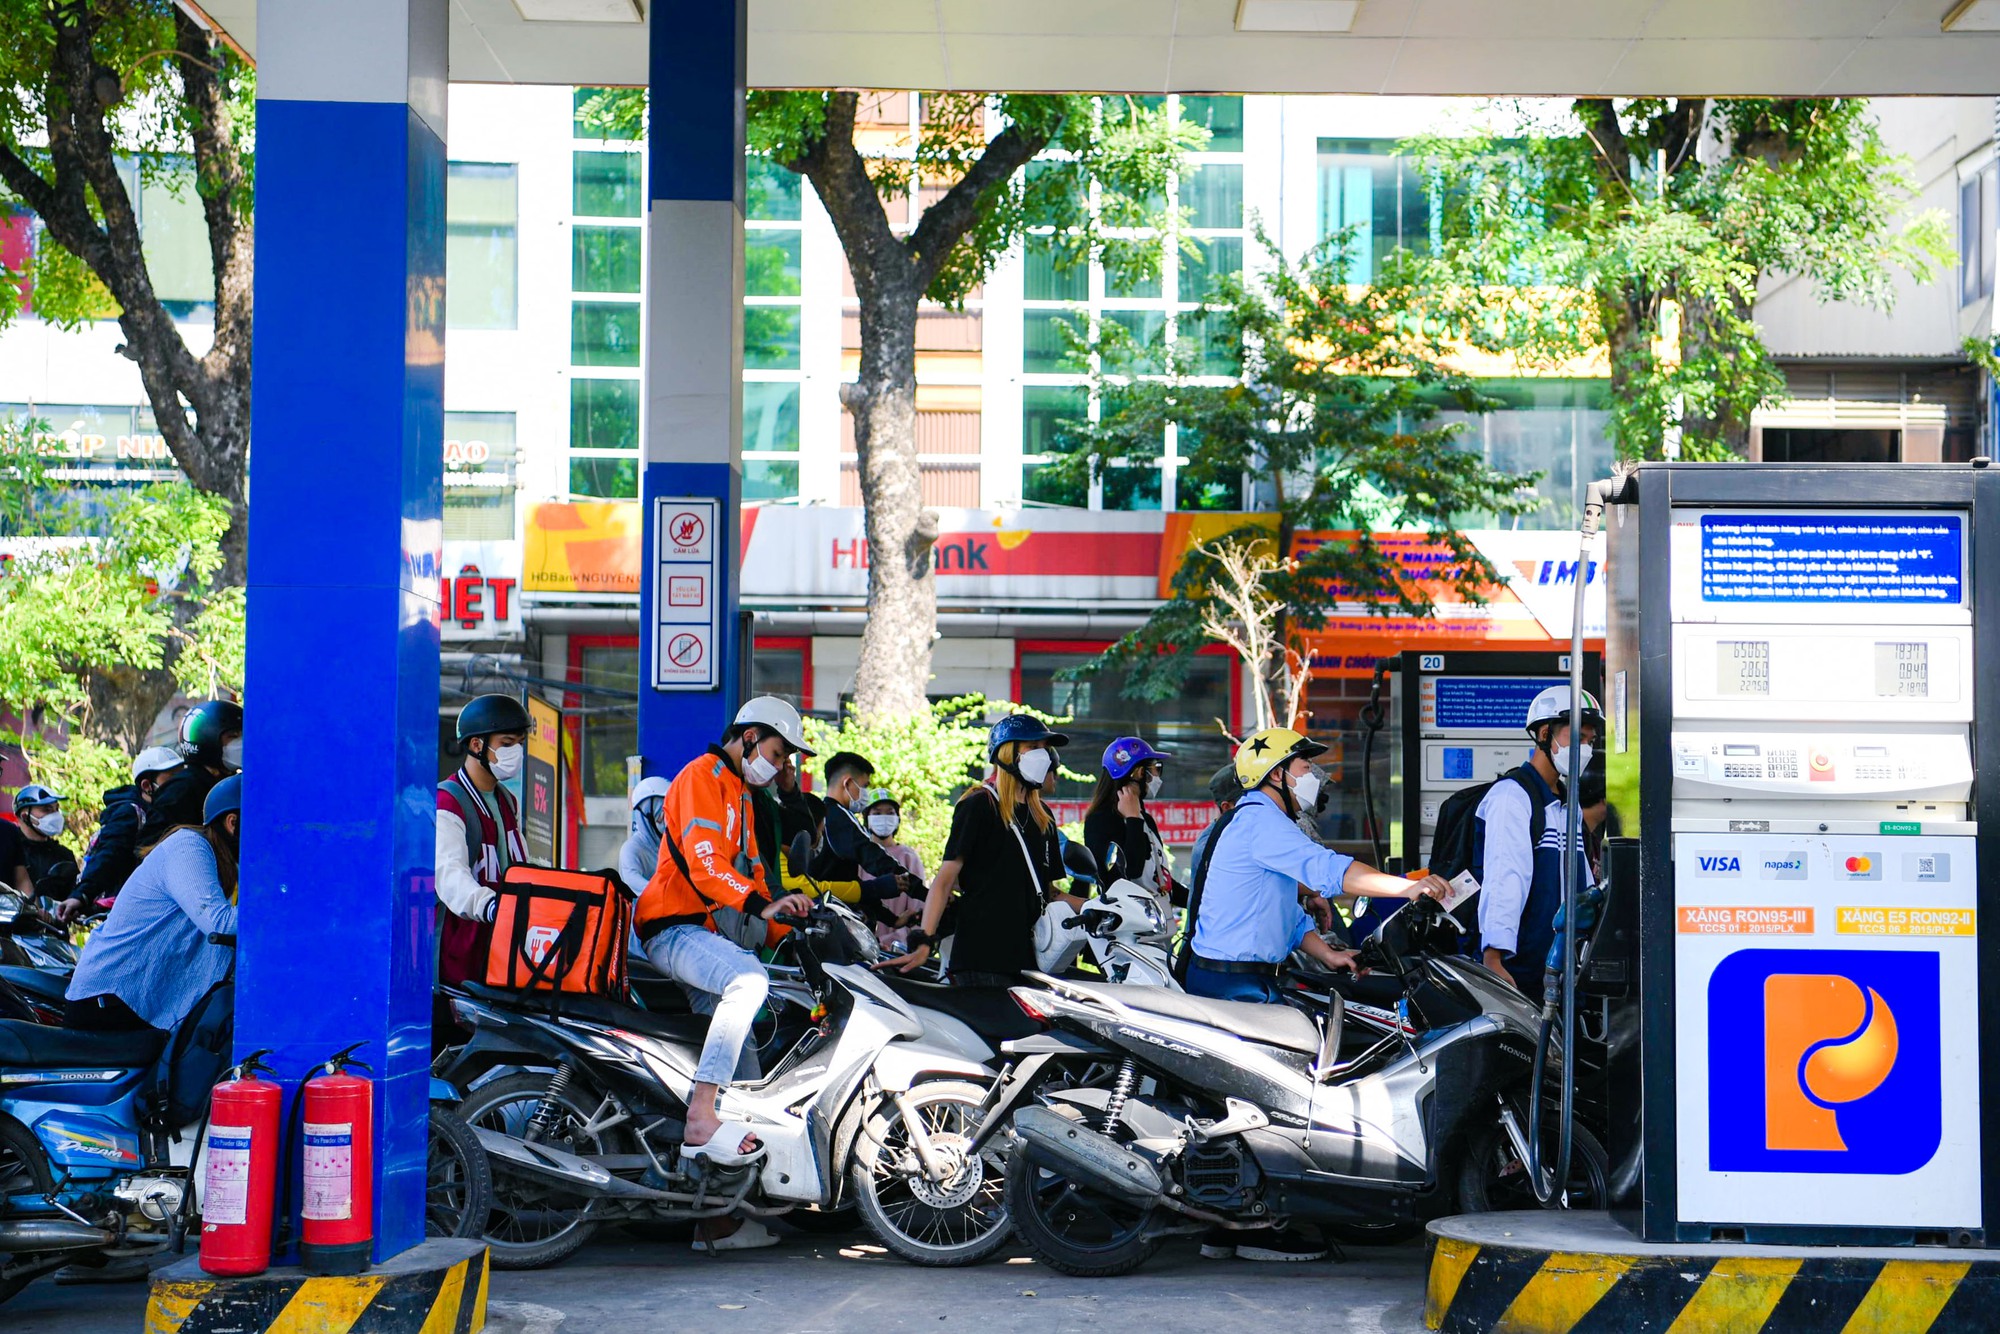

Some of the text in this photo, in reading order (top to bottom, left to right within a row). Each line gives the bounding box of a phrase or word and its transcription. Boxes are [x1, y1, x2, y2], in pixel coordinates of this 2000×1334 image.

[1423, 657, 1441, 669] 20
[1696, 857, 1741, 871] VISA
[1764, 861, 1794, 871] napas
[1686, 907, 1806, 923] XĂNG RON95-III
[1842, 908, 1970, 925] XĂNG E5 RON92-II
[1699, 924, 1726, 933] TCCS
[1728, 924, 1740, 933] 01
[1749, 924, 1794, 933] 2015/PLX
[1858, 924, 1886, 933] TCCS
[1909, 925, 1955, 934] 2015/PLX
[1499, 1042, 1532, 1063] HONDA
[56, 1140, 123, 1158] DREAM
